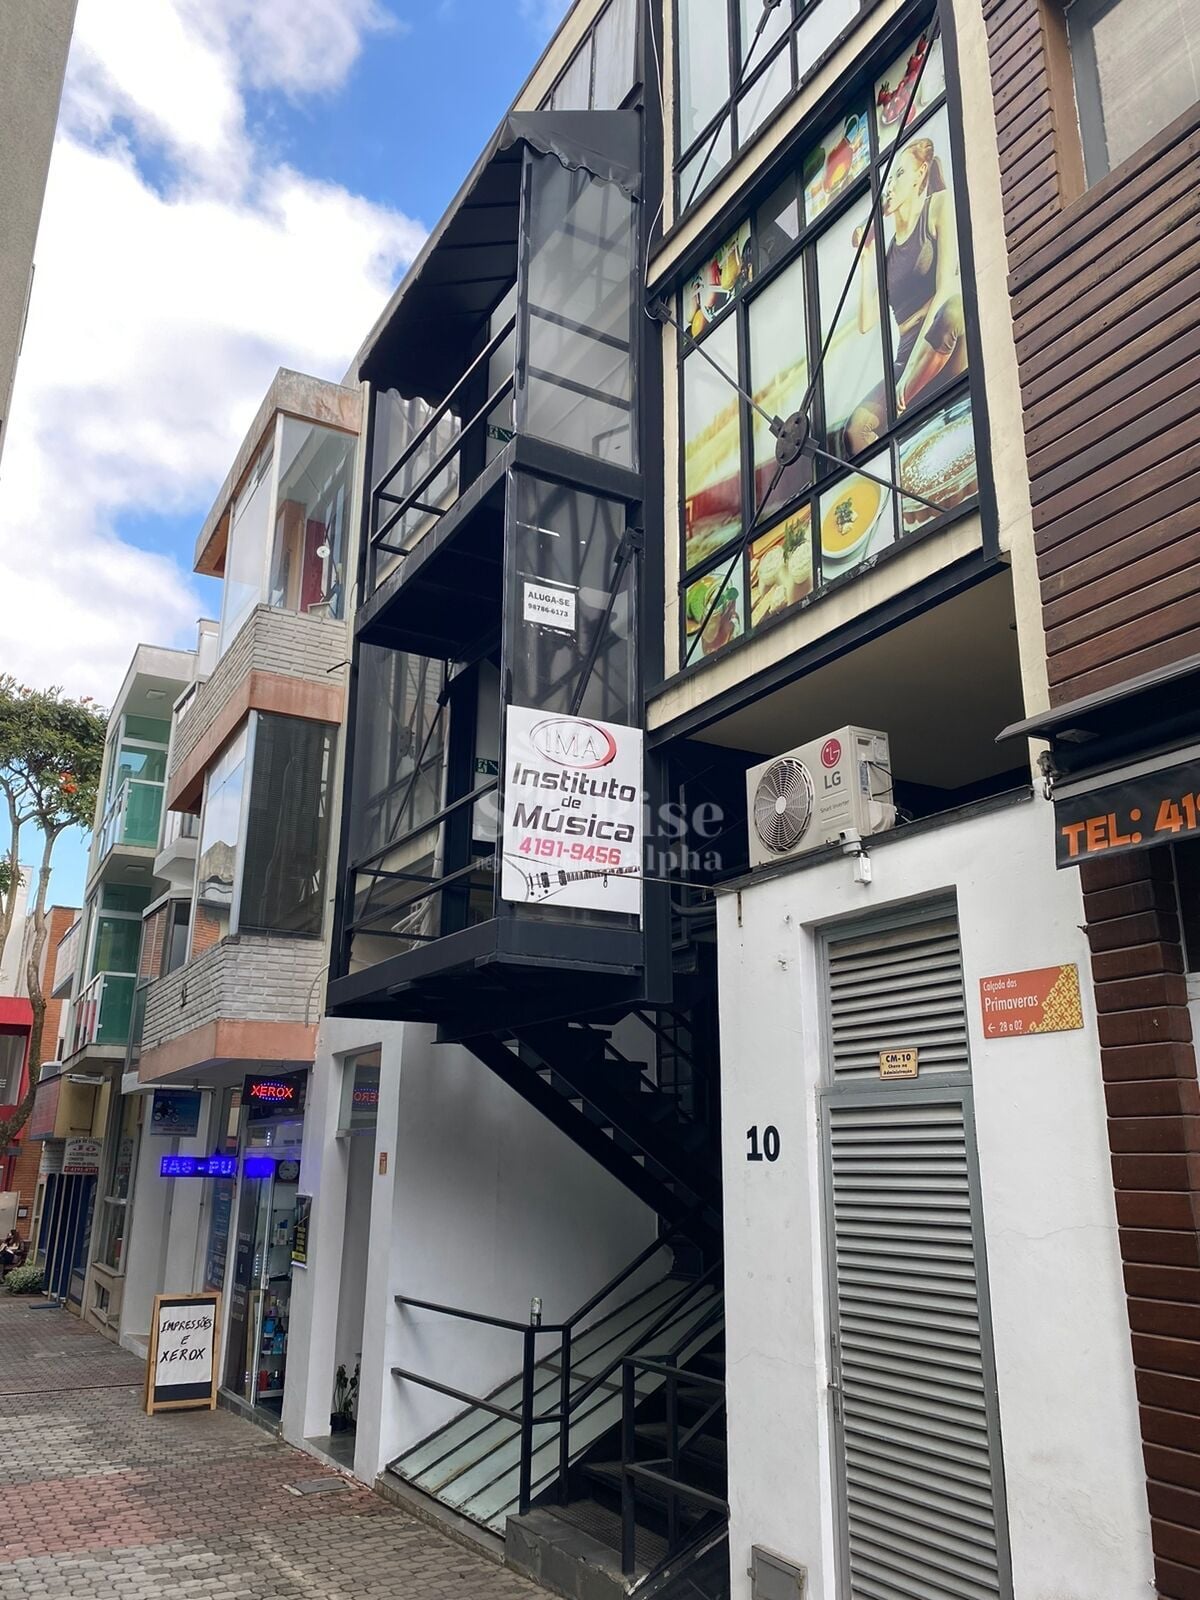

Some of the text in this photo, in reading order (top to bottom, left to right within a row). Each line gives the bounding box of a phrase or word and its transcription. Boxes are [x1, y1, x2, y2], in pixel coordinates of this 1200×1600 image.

[528, 591, 571, 607] ALUGA-SE
[545, 728, 601, 761] IMA
[512, 762, 637, 803] Instituto
[824, 771, 841, 789] LG
[561, 796, 582, 809] de
[512, 802, 636, 844] Música
[1061, 791, 1200, 857] TEL: 41
[519, 836, 622, 866] 4191-9456
[1006, 978, 1017, 988] das
[985, 995, 1038, 1012] Primaveras
[999, 1021, 1008, 1032] 28
[1014, 1020, 1023, 1030] 02
[885, 1054, 912, 1063] CM-10
[250, 1084, 294, 1099] XEROX
[747, 1125, 781, 1162] 10
[160, 1316, 213, 1333] IMPRESSÕES
[180, 1334, 191, 1345] E
[159, 1347, 206, 1364] XEROX
